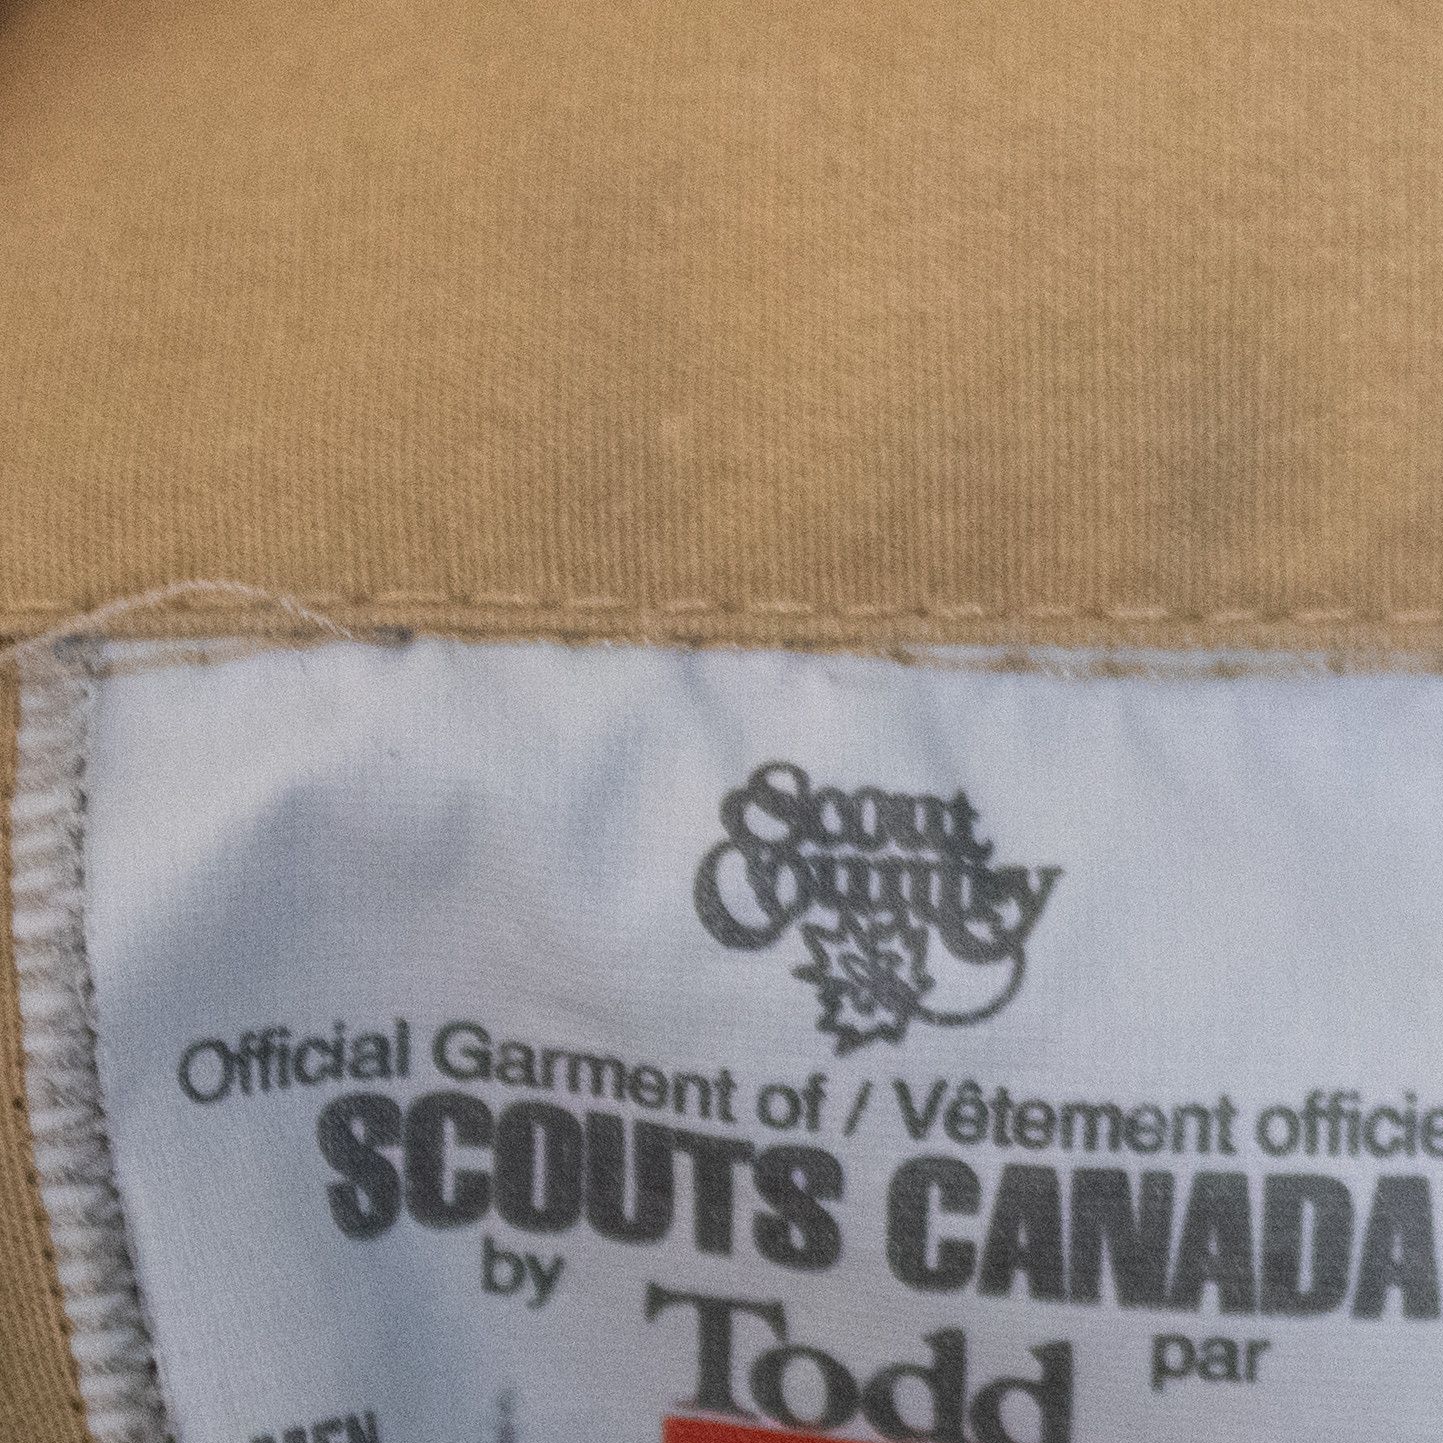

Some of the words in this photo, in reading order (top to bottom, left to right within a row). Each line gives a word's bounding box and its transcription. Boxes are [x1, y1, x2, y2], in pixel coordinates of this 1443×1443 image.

[719, 759, 996, 866] Scout
[177, 1015, 411, 1105] Official
[431, 1020, 738, 1124] Garment
[756, 1072, 831, 1132] of
[842, 1077, 876, 1138] /
[892, 1077, 1239, 1156] Vêtement
[315, 1090, 845, 1273] SCOUTS
[884, 1155, 1442, 1321] CANADA
[481, 1233, 567, 1309] by
[1150, 1332, 1272, 1391] par
